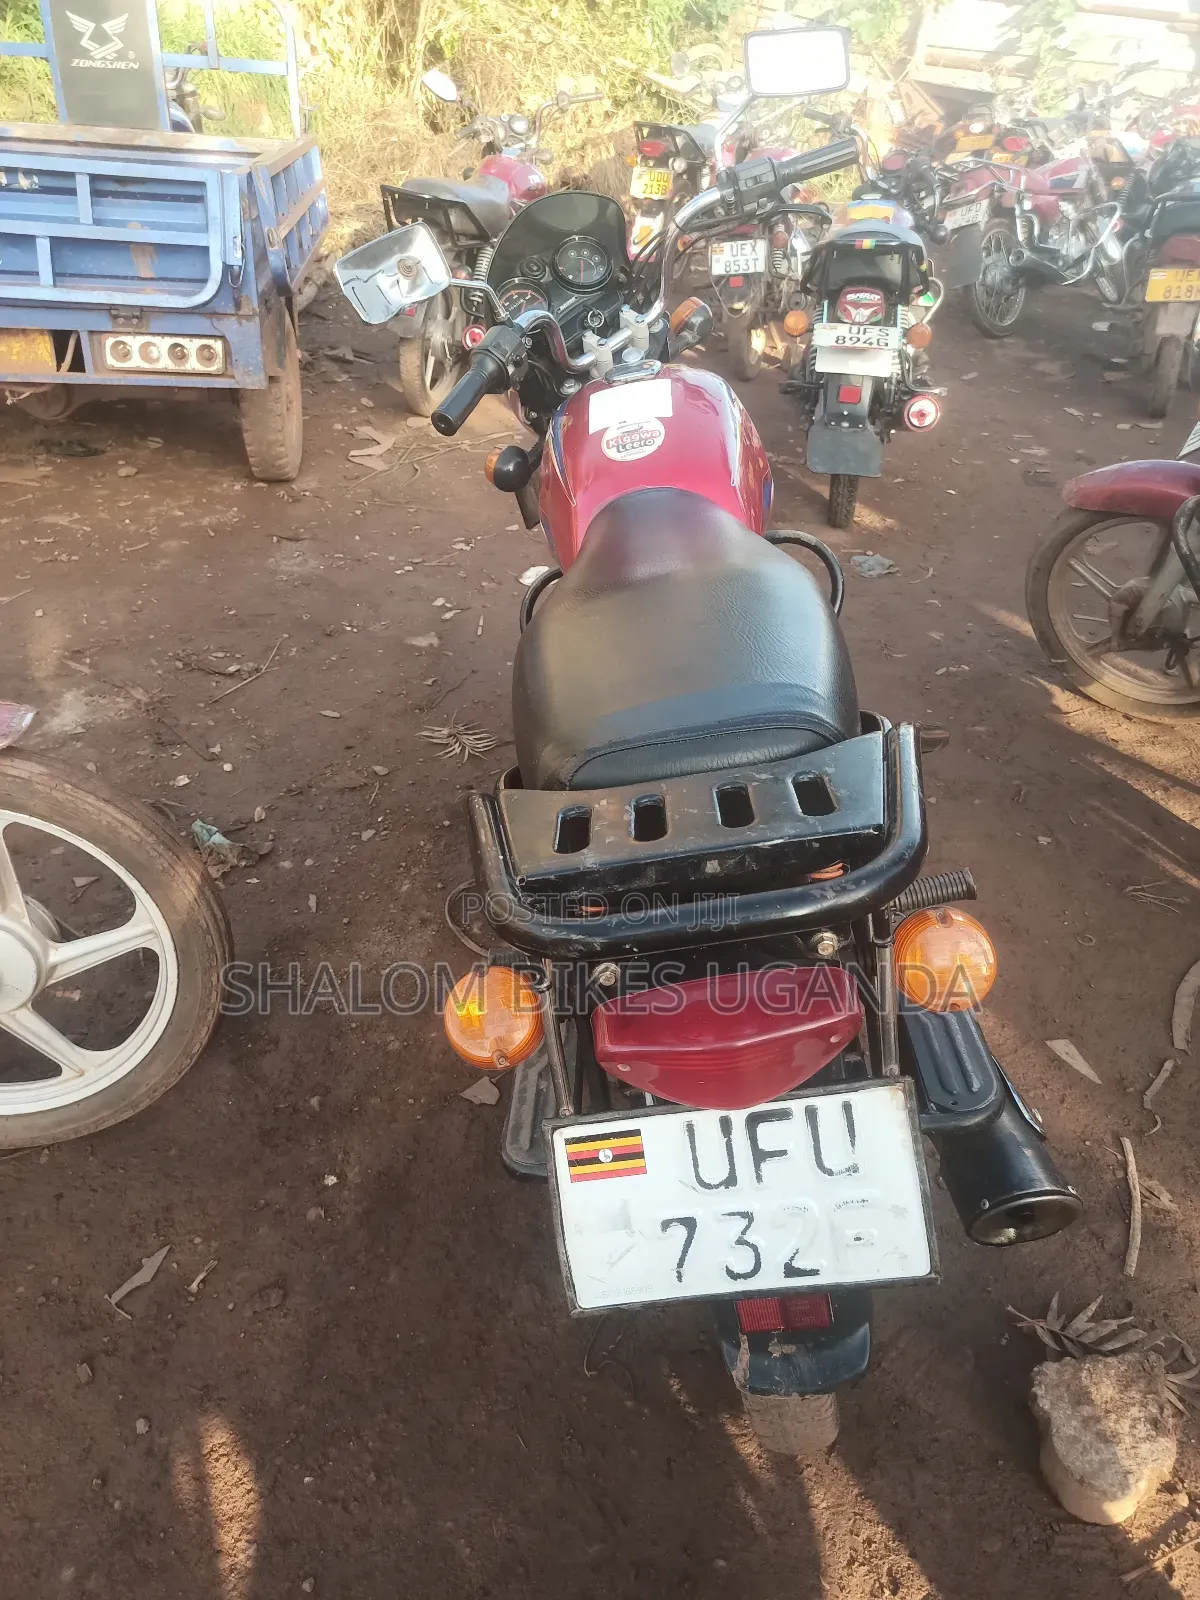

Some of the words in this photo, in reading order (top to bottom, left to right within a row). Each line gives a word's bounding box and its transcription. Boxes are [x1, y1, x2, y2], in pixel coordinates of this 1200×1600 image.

[71, 59, 139, 69] ZONGSHEN
[730, 240, 758, 257] UEX
[724, 258, 759, 273] 853T
[1175, 269, 1200, 282] UE
[848, 326, 890, 337] UFS
[834, 335, 889, 347] 894G
[616, 438, 656, 453] Leero
[683, 1100, 861, 1192] UFU
